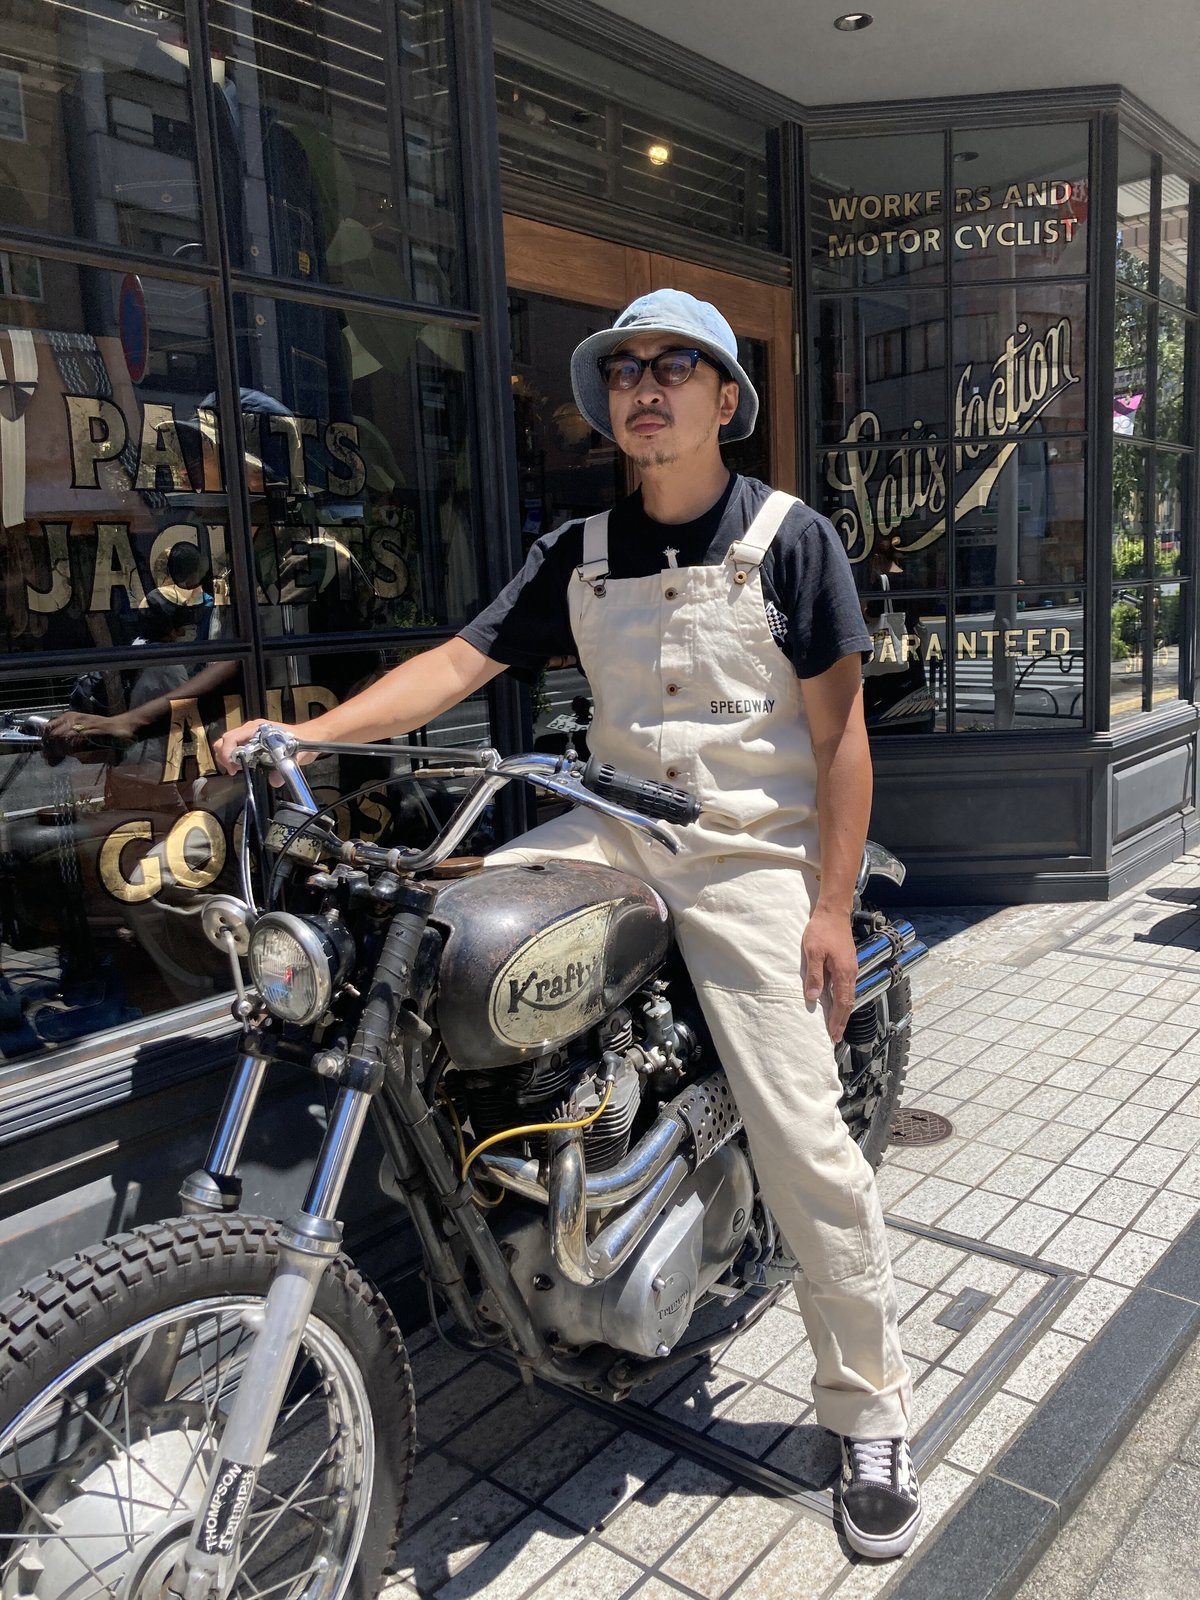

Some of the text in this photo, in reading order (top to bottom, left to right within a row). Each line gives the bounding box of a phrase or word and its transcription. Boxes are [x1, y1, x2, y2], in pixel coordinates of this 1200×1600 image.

[1002, 180, 1073, 209] AND
[828, 218, 1078, 258] MOTOR CYCLIST
[710, 700, 775, 723] SPEEDWAY
[205, 1463, 243, 1552] THOMPSON
